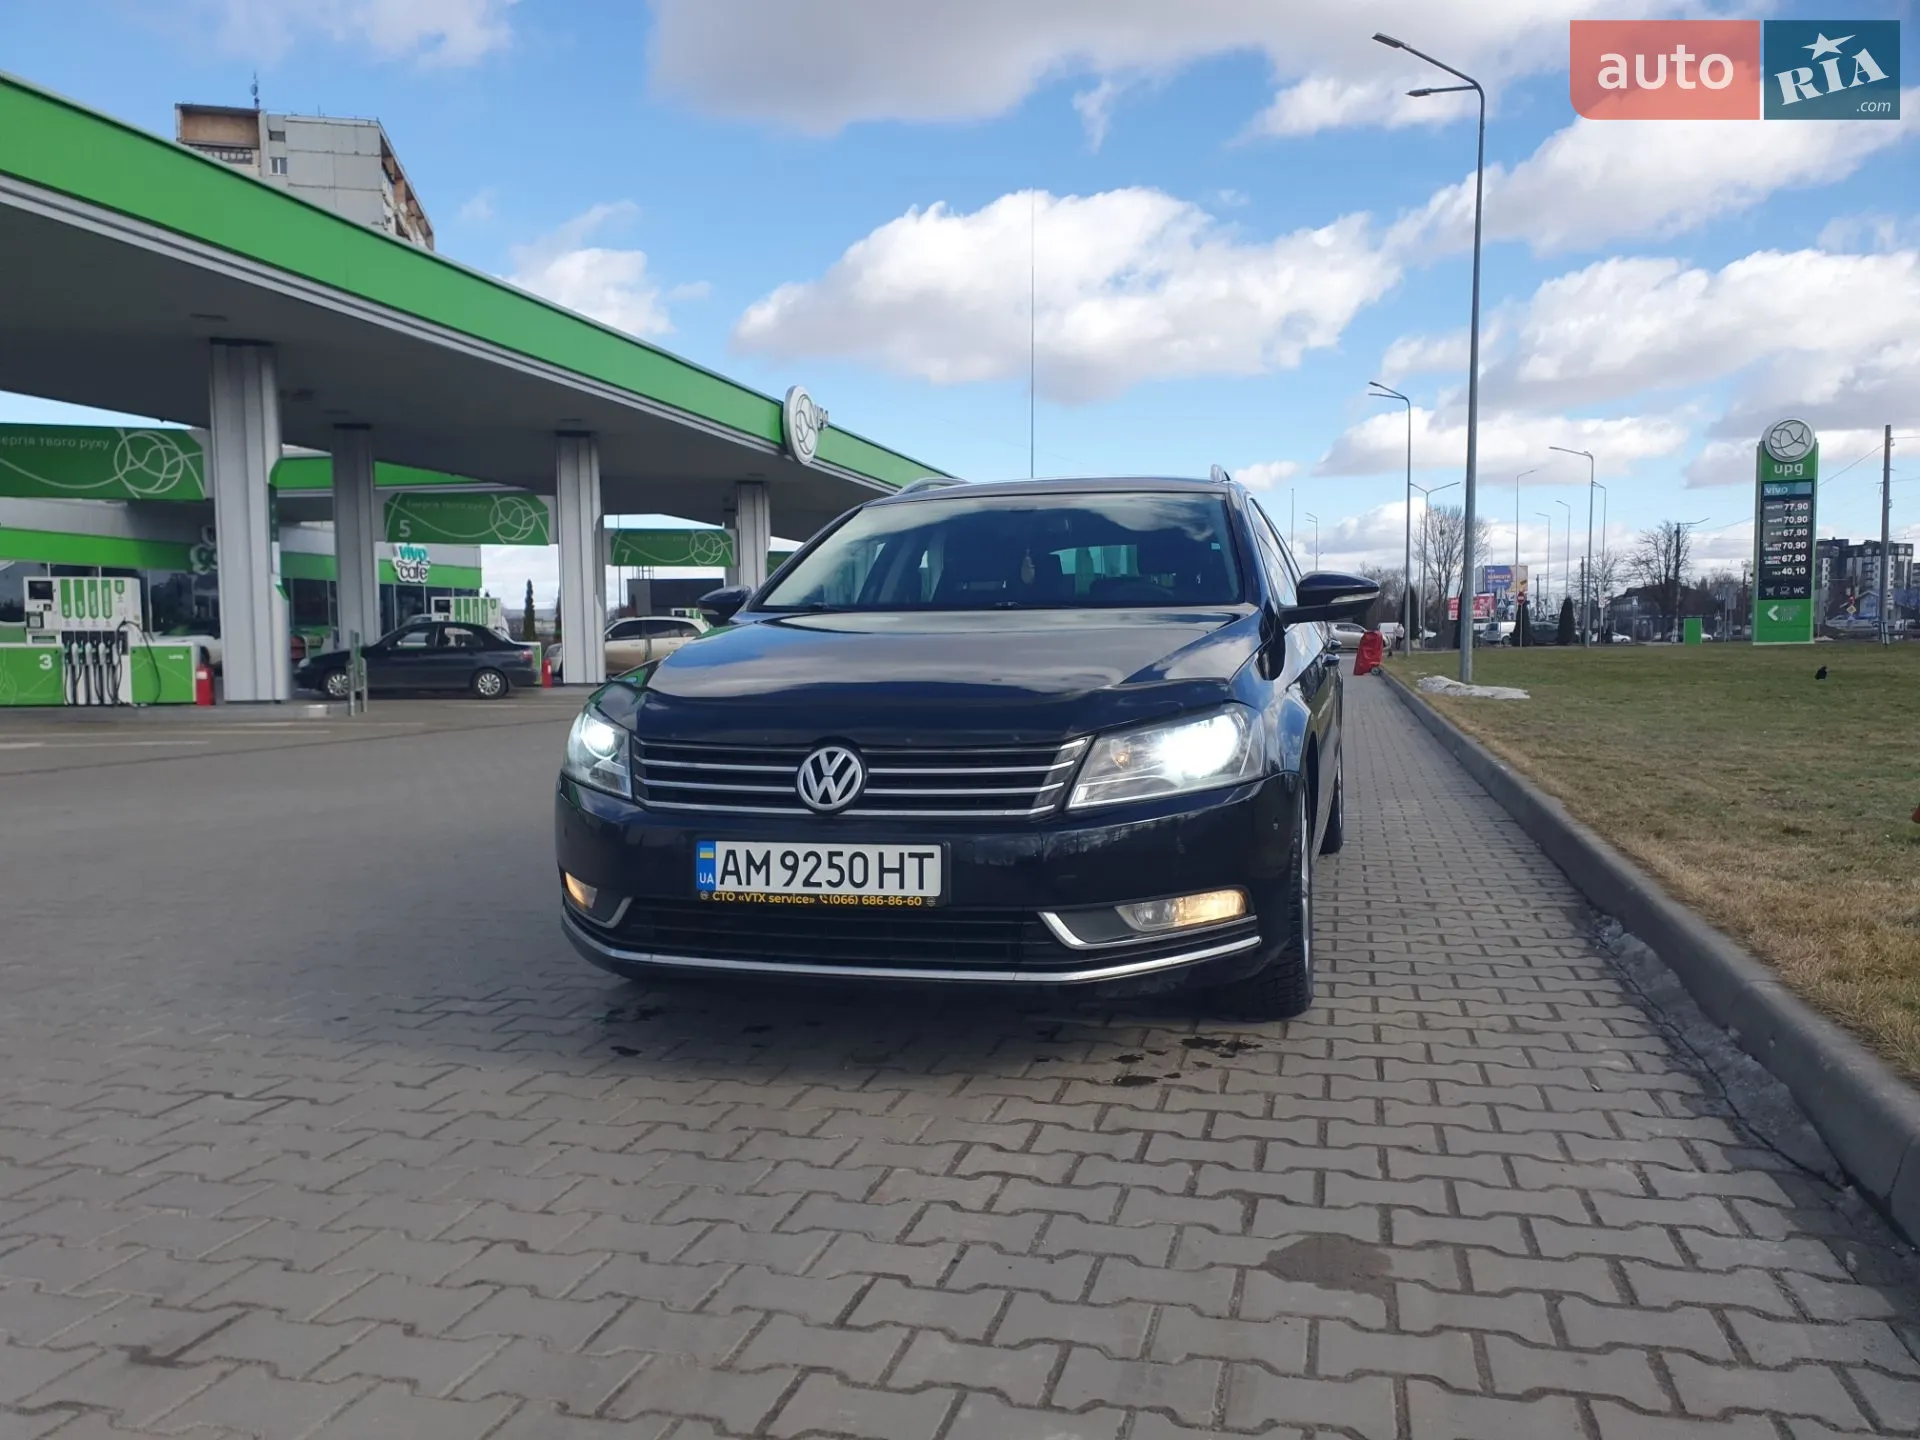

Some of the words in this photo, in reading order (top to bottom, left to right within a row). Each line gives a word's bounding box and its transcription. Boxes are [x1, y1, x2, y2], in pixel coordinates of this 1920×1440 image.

[79, 438, 110, 451] руху
[1774, 463, 1804, 477] upg
[1784, 503, 1809, 512] 77,90
[1783, 515, 1808, 525] 70,90
[399, 519, 411, 538] 5
[1783, 528, 1808, 537] 67,90
[1782, 541, 1807, 550] 70,90
[621, 548, 631, 563] 7
[1781, 554, 1807, 563] 67,90
[1781, 567, 1806, 576] 40,10
[1793, 586, 1805, 594] WC
[39, 654, 53, 670] 3
[719, 848, 771, 887] AM
[780, 849, 869, 889] 9250
[878, 851, 935, 890] HT
[699, 871, 715, 884] UA
[712, 891, 735, 902] СТО
[768, 893, 816, 905] service»
[829, 895, 859, 906] (066)
[862, 895, 923, 907] 686-86-60
